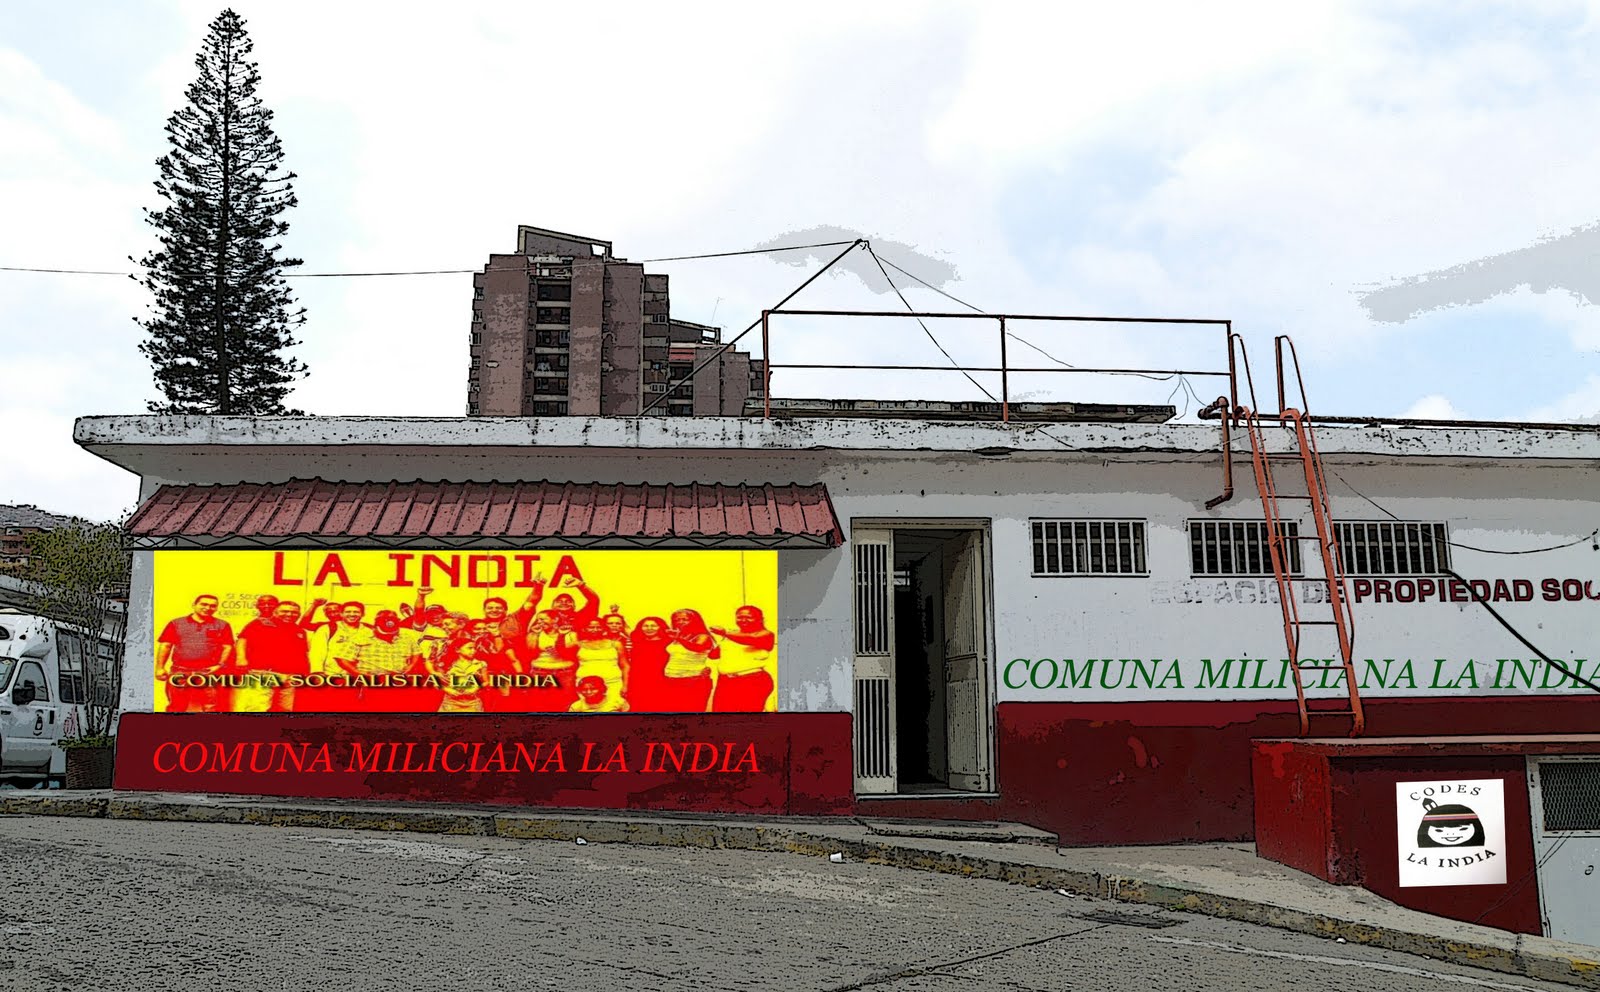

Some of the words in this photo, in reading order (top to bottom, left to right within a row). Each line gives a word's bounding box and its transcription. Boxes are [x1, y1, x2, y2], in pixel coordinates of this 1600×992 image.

[273, 551, 352, 587] LA
[387, 553, 585, 588] INDIA
[1353, 579, 1534, 603] PROPIEDAD
[169, 673, 280, 687] COMUNA
[289, 673, 440, 687] SOCIALISTA
[450, 674, 479, 687] LA
[489, 674, 558, 687] INDIA
[1410, 784, 1482, 801] CODES
[1406, 852, 1429, 866] LA
[1438, 849, 1497, 868] INDIA
